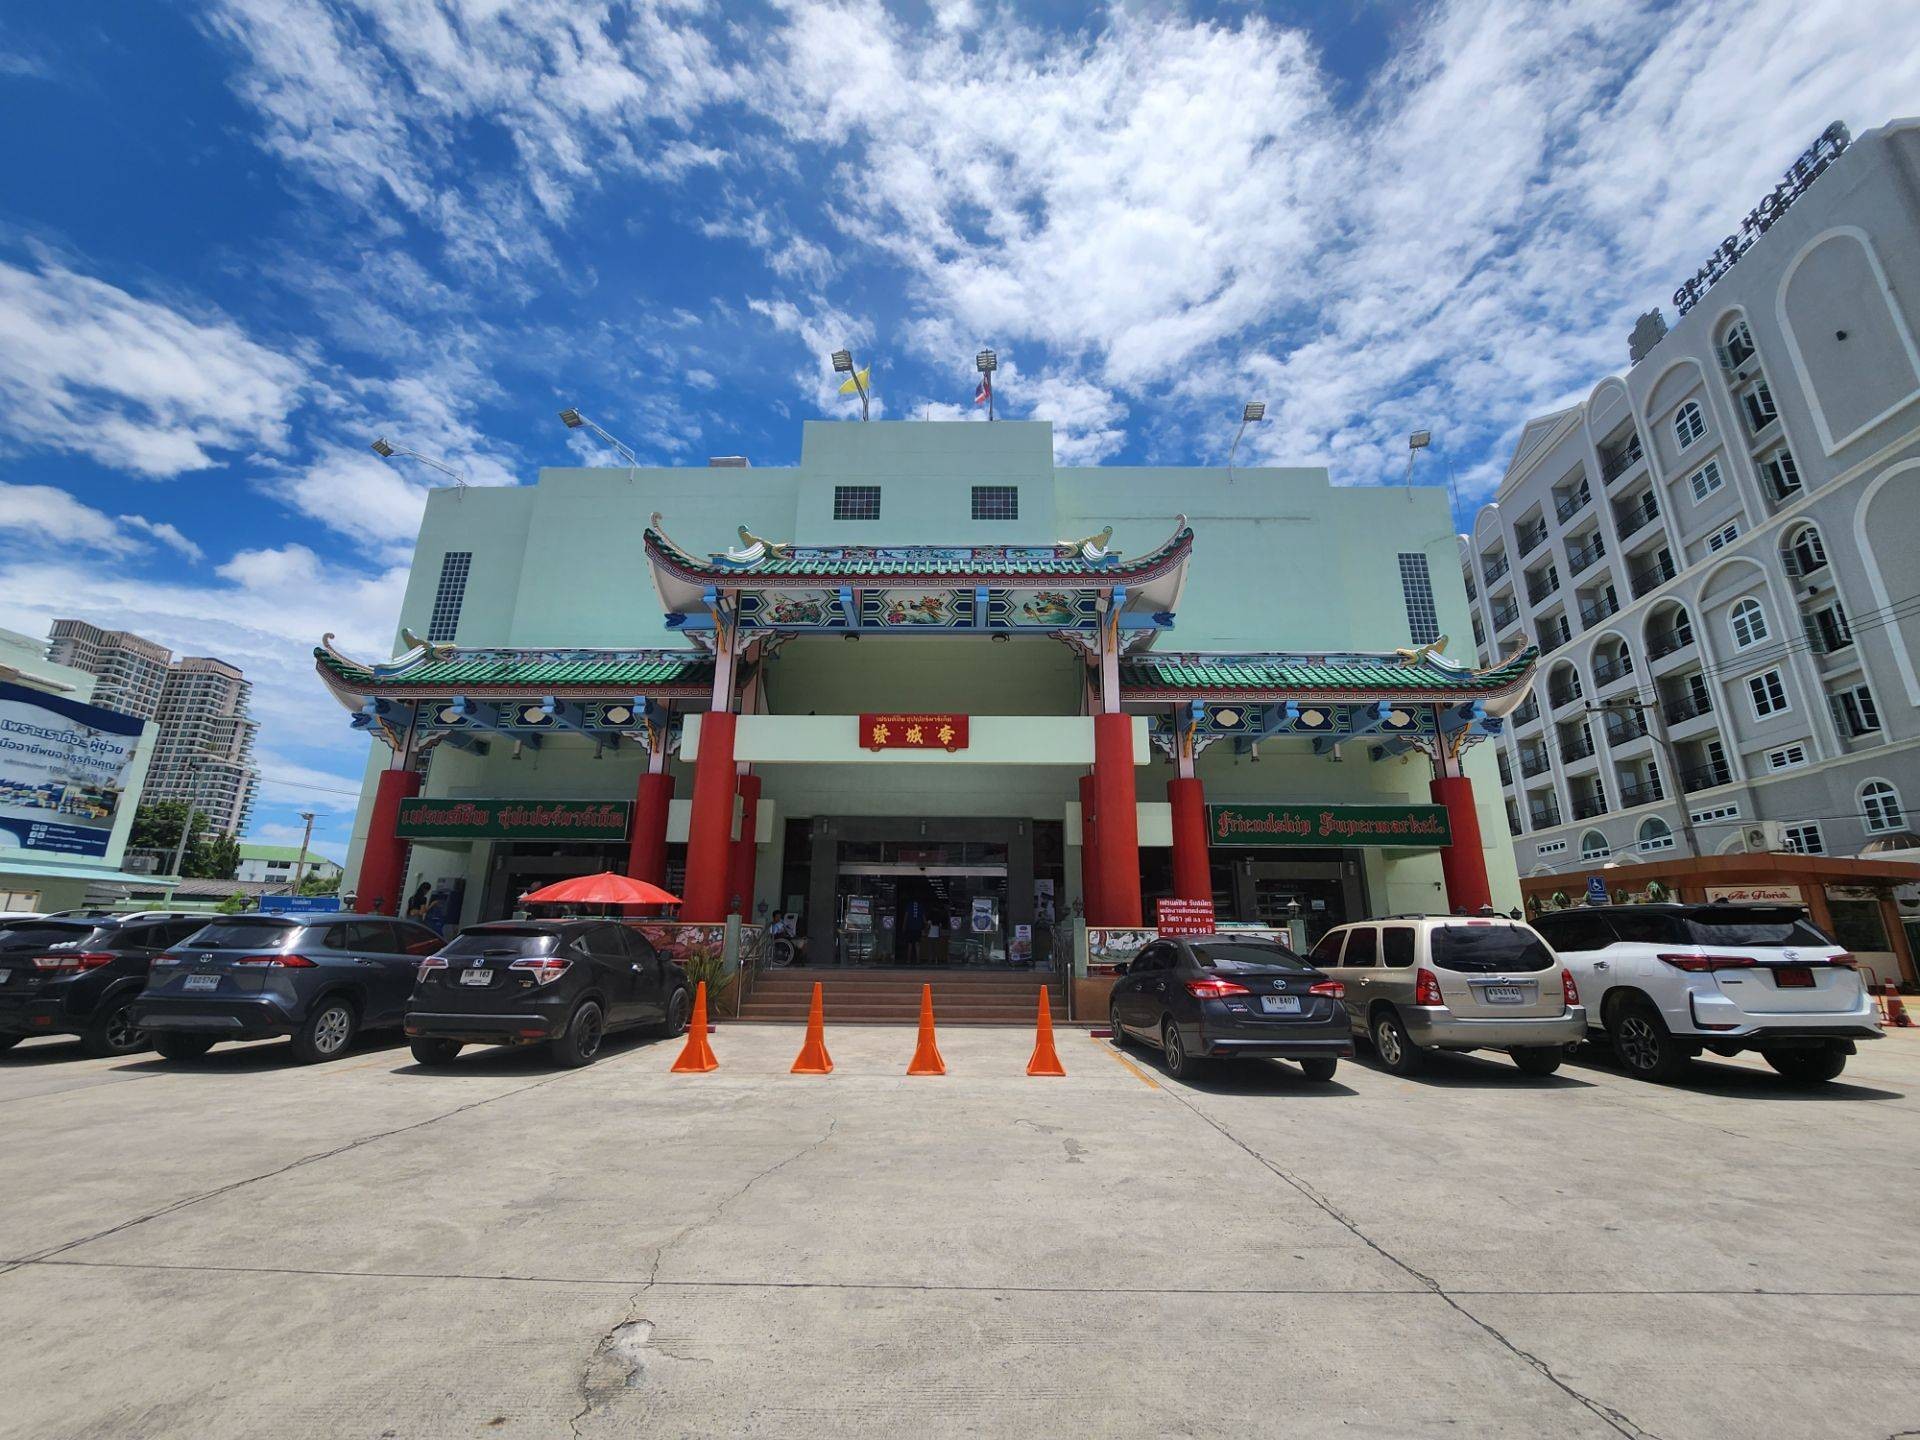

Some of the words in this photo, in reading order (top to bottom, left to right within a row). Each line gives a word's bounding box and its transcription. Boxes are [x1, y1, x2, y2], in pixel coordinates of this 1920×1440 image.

[1673, 235, 1738, 305] GRAND
[90, 738, 124, 755] ผู้ช่วย
[1218, 811, 1311, 838] Friendship
[1728, 890, 1749, 900] The
[1751, 890, 1791, 900] Florist
